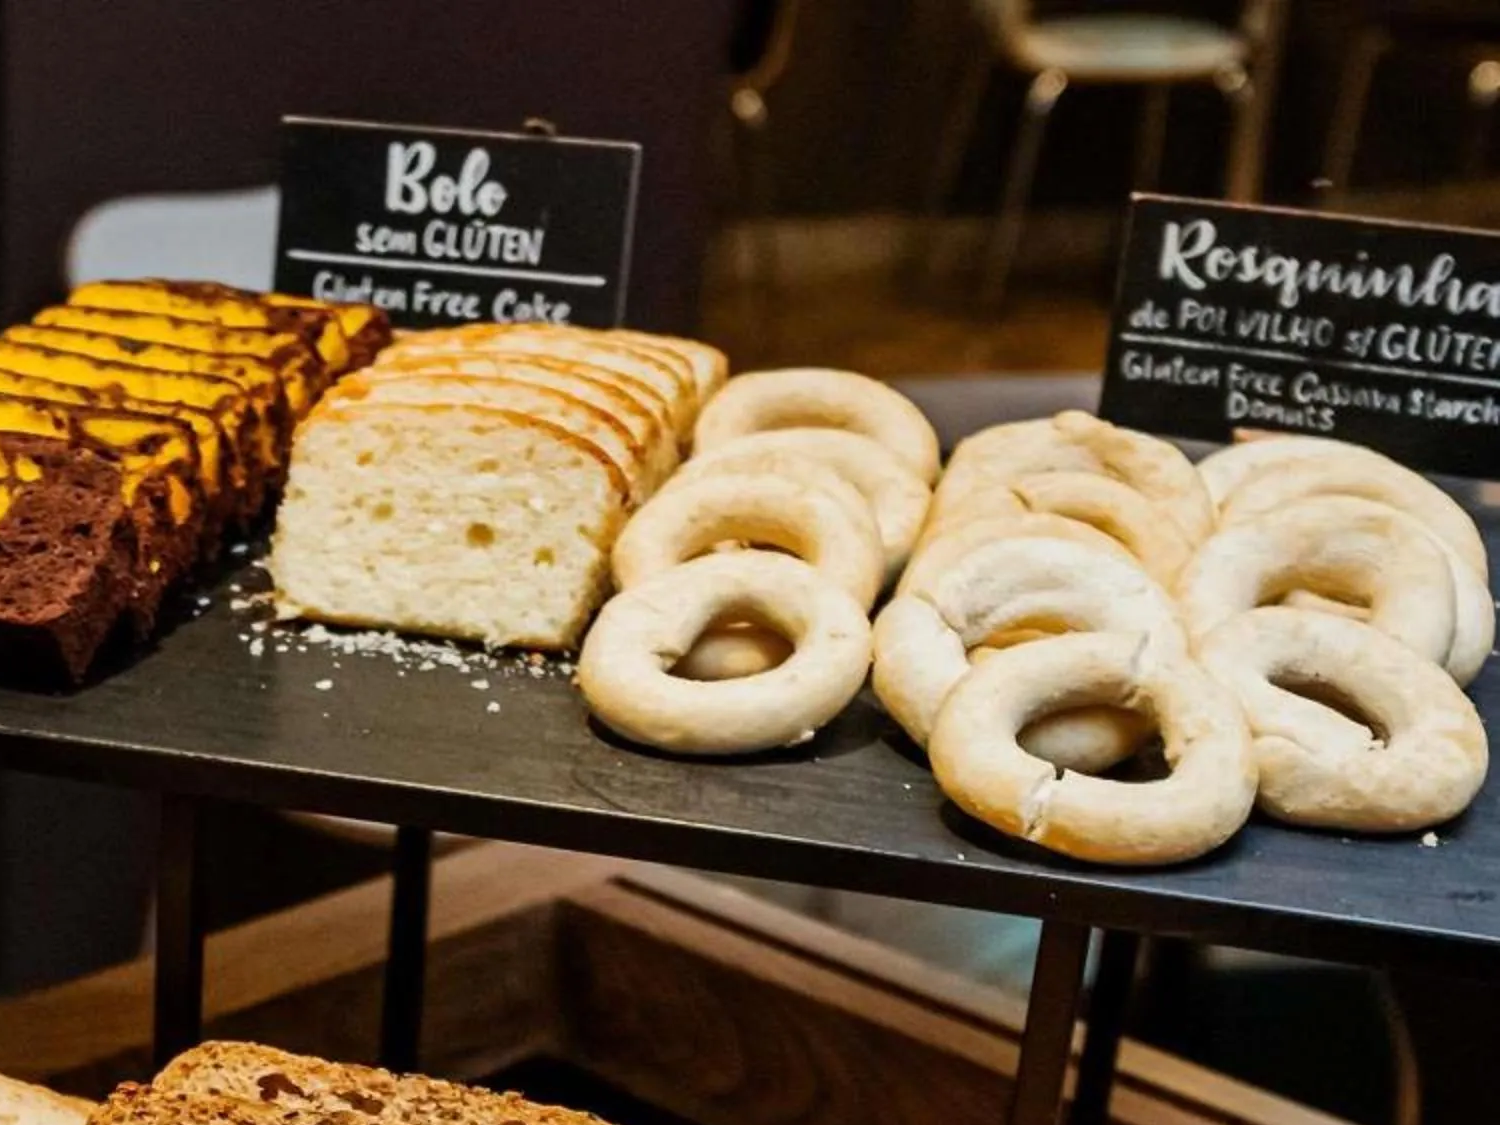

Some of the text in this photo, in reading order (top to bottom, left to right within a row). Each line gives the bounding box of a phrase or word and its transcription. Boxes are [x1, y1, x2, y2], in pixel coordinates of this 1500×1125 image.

[385, 140, 508, 217] Bolo
[355, 219, 545, 265] sem GLÚTEN
[1159, 218, 1500, 318] Rosquinha
[413, 280, 481, 320] Free
[492, 287, 573, 325] Cake
[1129, 301, 1170, 330] de
[1121, 351, 1220, 387] Gluten
[1227, 362, 1285, 397] Free
[1409, 388, 1500, 425] Starch
[1226, 391, 1335, 432] Donuts
